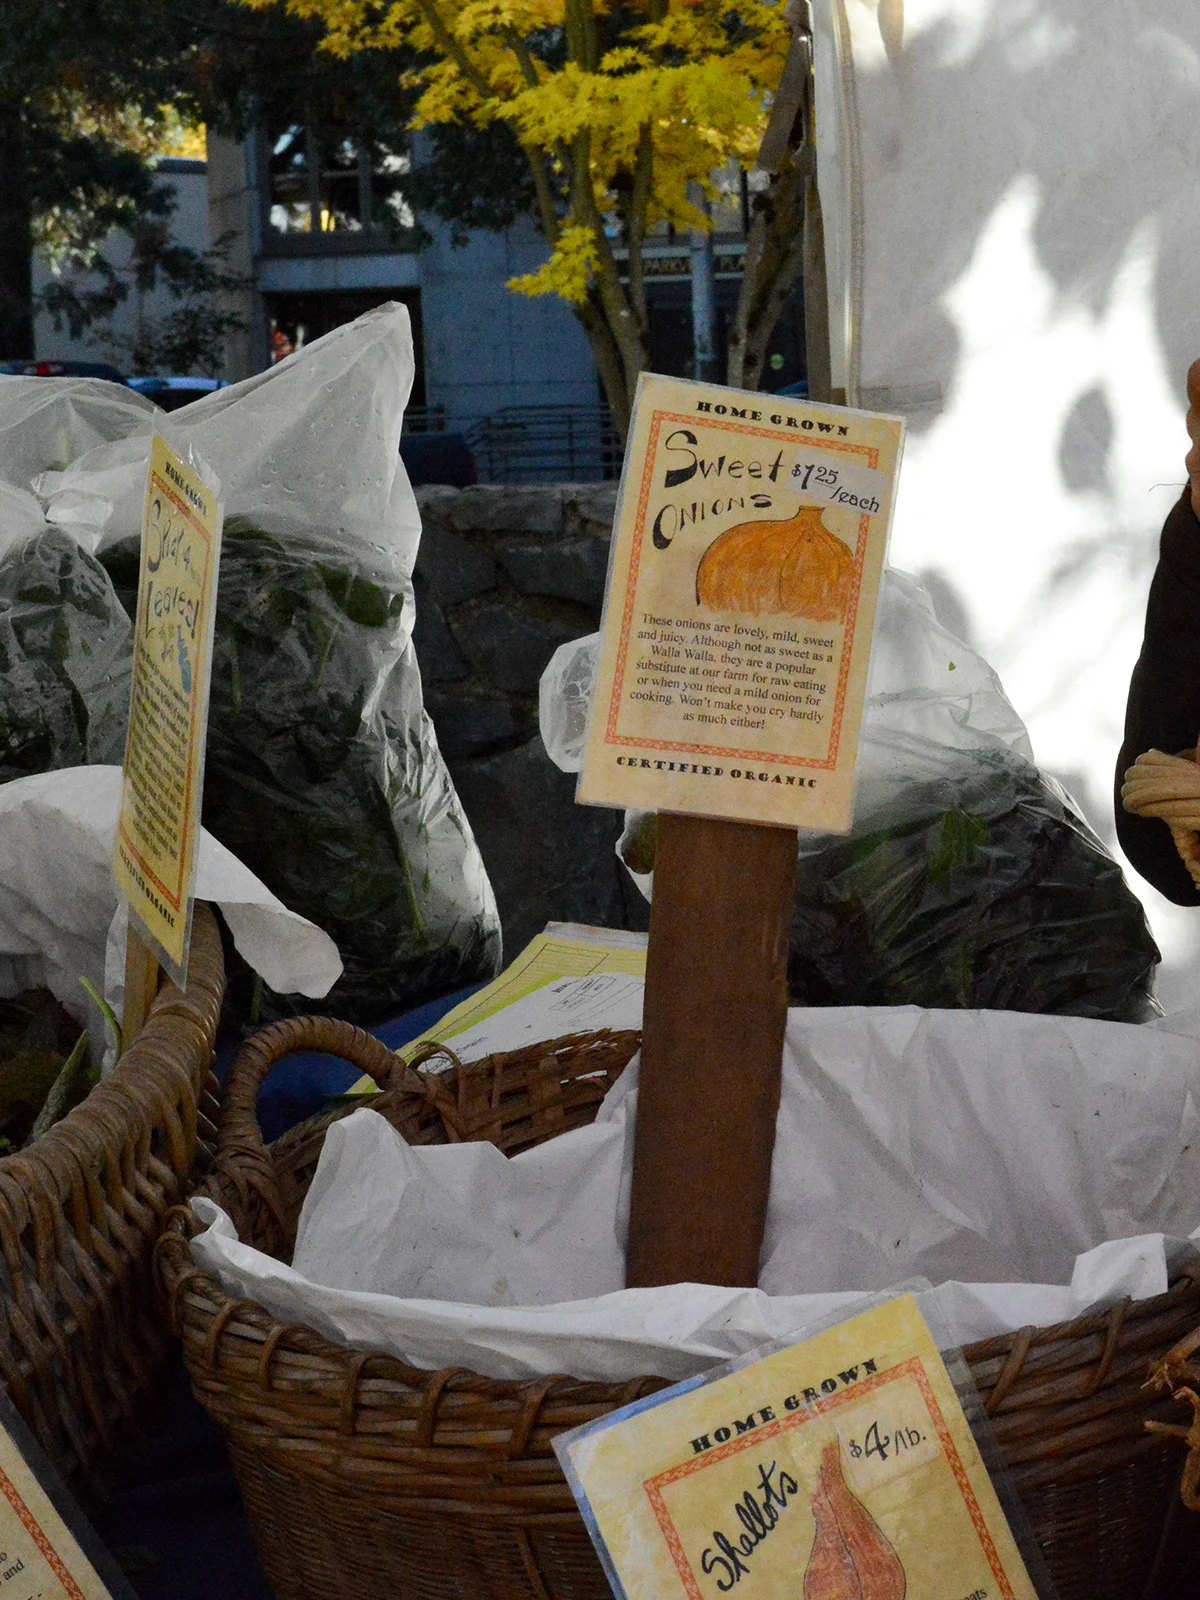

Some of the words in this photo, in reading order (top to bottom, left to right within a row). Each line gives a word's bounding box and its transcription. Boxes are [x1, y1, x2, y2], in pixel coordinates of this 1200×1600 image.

[696, 401, 762, 422] HOME
[770, 413, 850, 437] GROWN
[664, 430, 784, 489] Sweet
[637, 629, 657, 641] and
[659, 630, 688, 646] juicy.
[691, 634, 741, 652] Although
[744, 643, 762, 653] not
[764, 645, 776, 655] as
[779, 648, 809, 660] sweet
[812, 652, 824, 663] as
[826, 654, 833, 663] a
[642, 612, 673, 627] These
[675, 618, 711, 631] onions
[713, 623, 731, 633] are
[733, 624, 769, 640] lovely,
[772, 631, 800, 644] mild,
[803, 636, 834, 649] sweet
[636, 659, 687, 675] substitute
[689, 666, 700, 676] at
[702, 667, 721, 677] our
[723, 668, 749, 682] farm
[752, 672, 768, 684] for
[770, 677, 791, 687] raw
[793, 680, 827, 695] eating
[651, 644, 681, 659] Walla
[720, 652, 744, 668] they
[746, 658, 764, 668] are
[766, 661, 773, 670] a
[775, 662, 817, 676] popular
[629, 691, 676, 706] cooking.
[679, 694, 712, 708] Won't
[714, 698, 744, 712] make
[746, 704, 767, 715] you
[769, 708, 786, 719] cry
[789, 707, 825, 725] hardly
[637, 676, 650, 686] or
[652, 676, 680, 689] when
[682, 682, 704, 692] you
[706, 684, 732, 695] need
[734, 687, 741, 696] a
[743, 687, 769, 700] mild
[771, 691, 802, 704] onion
[805, 694, 822, 707] for
[682, 712, 695, 721] as
[697, 713, 728, 726] much
[730, 716, 766, 730] either!
[616, 756, 725, 777] CERTIFIED
[729, 768, 818, 789] ORGANIC
[145, 887, 175, 928] ORGANIC
[690, 1405, 776, 1455] HOME
[783, 1357, 878, 1412] GROWN
[701, 1460, 798, 1592] Shallots
[3, 1557, 25, 1581] and
